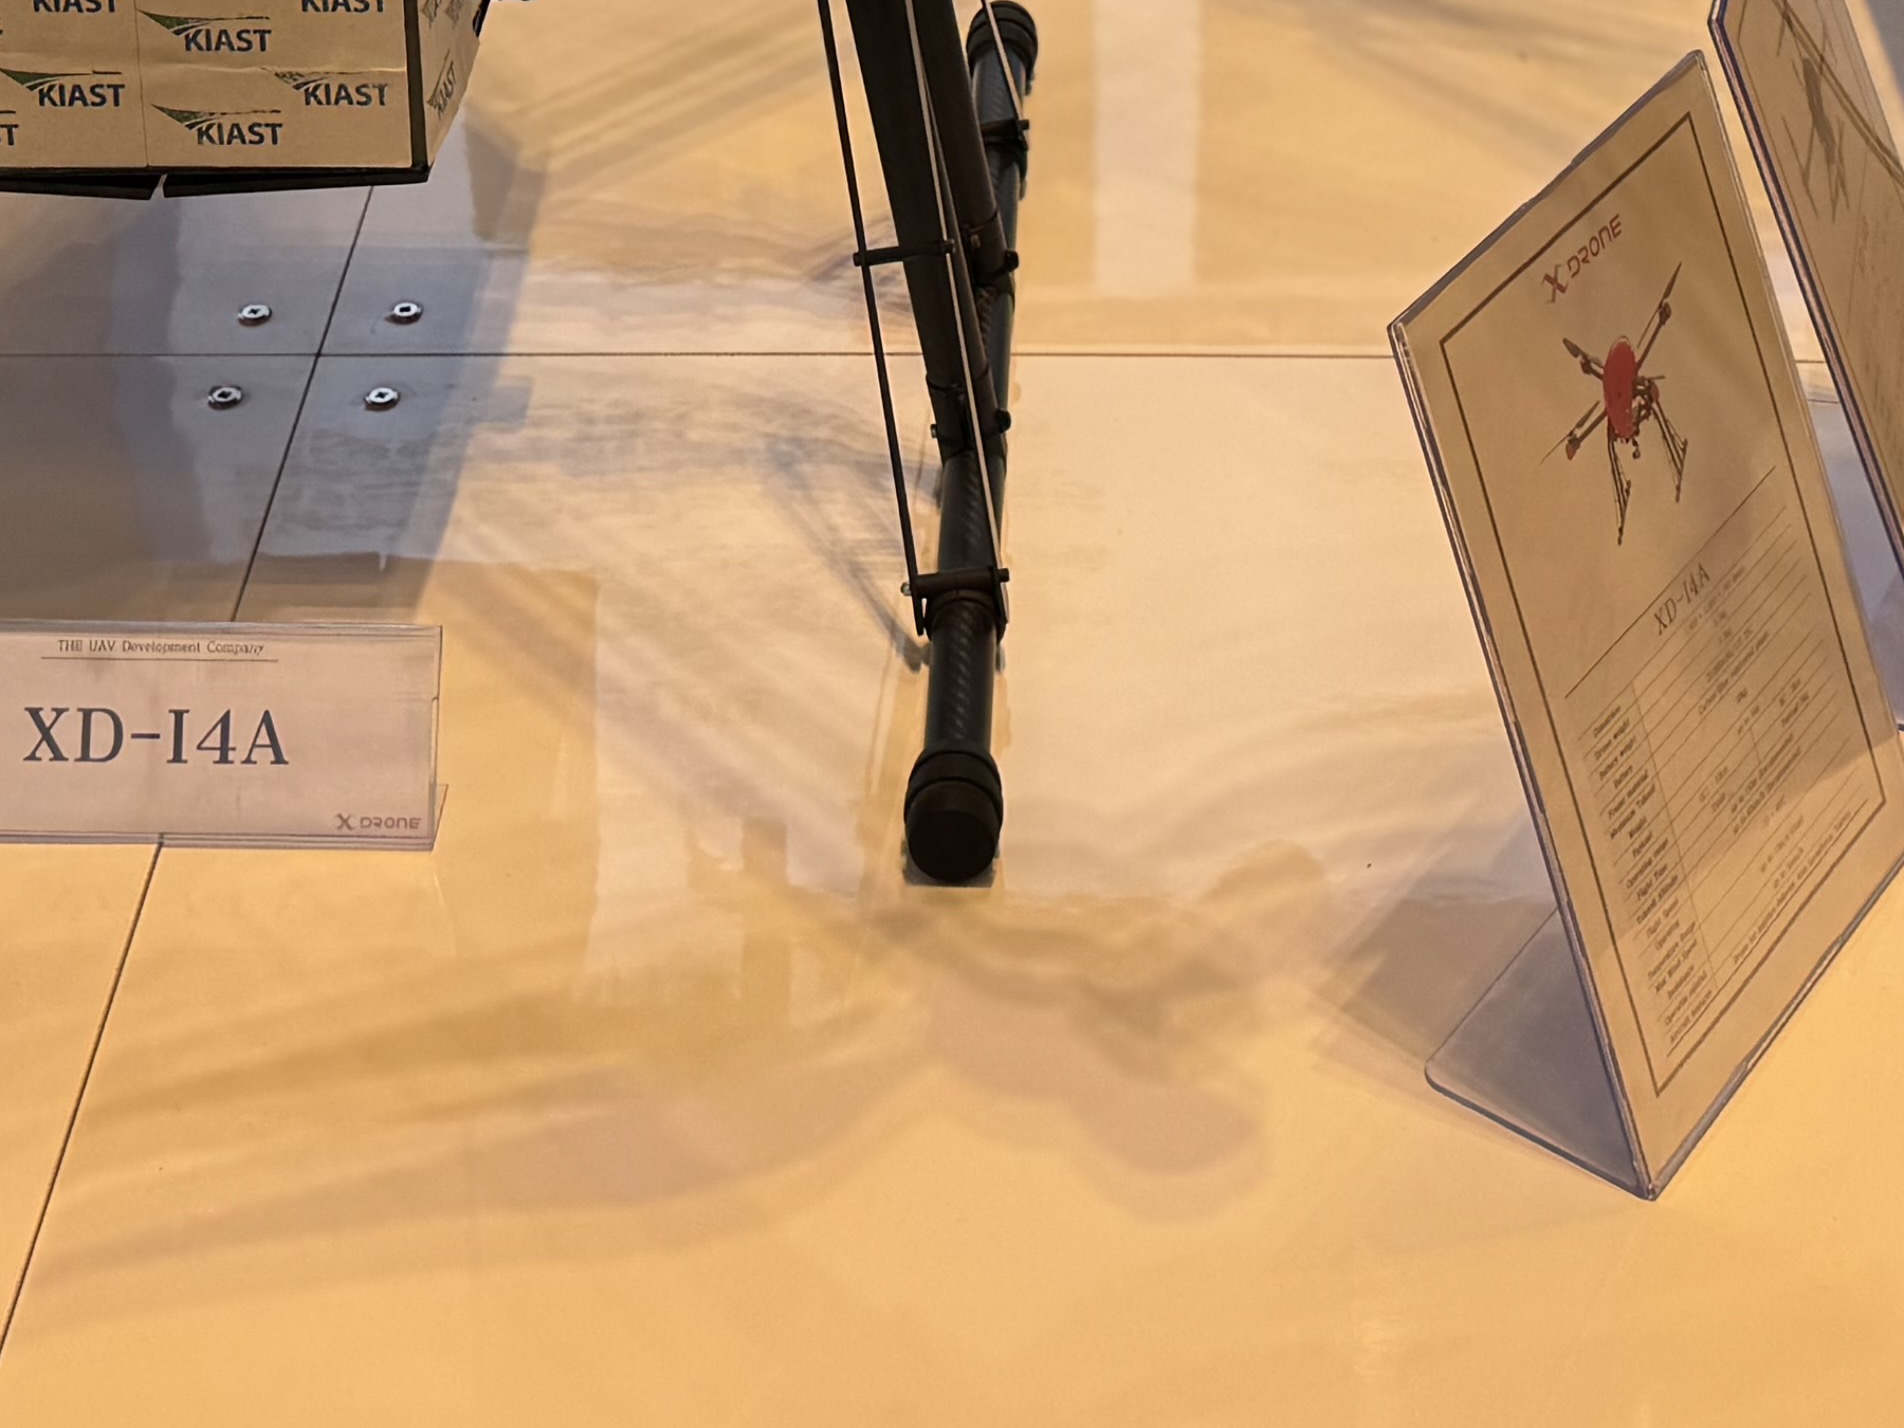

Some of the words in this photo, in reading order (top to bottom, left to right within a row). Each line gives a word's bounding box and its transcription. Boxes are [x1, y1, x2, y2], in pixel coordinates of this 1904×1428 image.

[180, 28, 272, 52] KIAST
[34, 83, 125, 107] KIAST
[300, 83, 389, 106] KIAST
[192, 122, 283, 145] KIAST
[24, 707, 289, 765] XD-I4A
